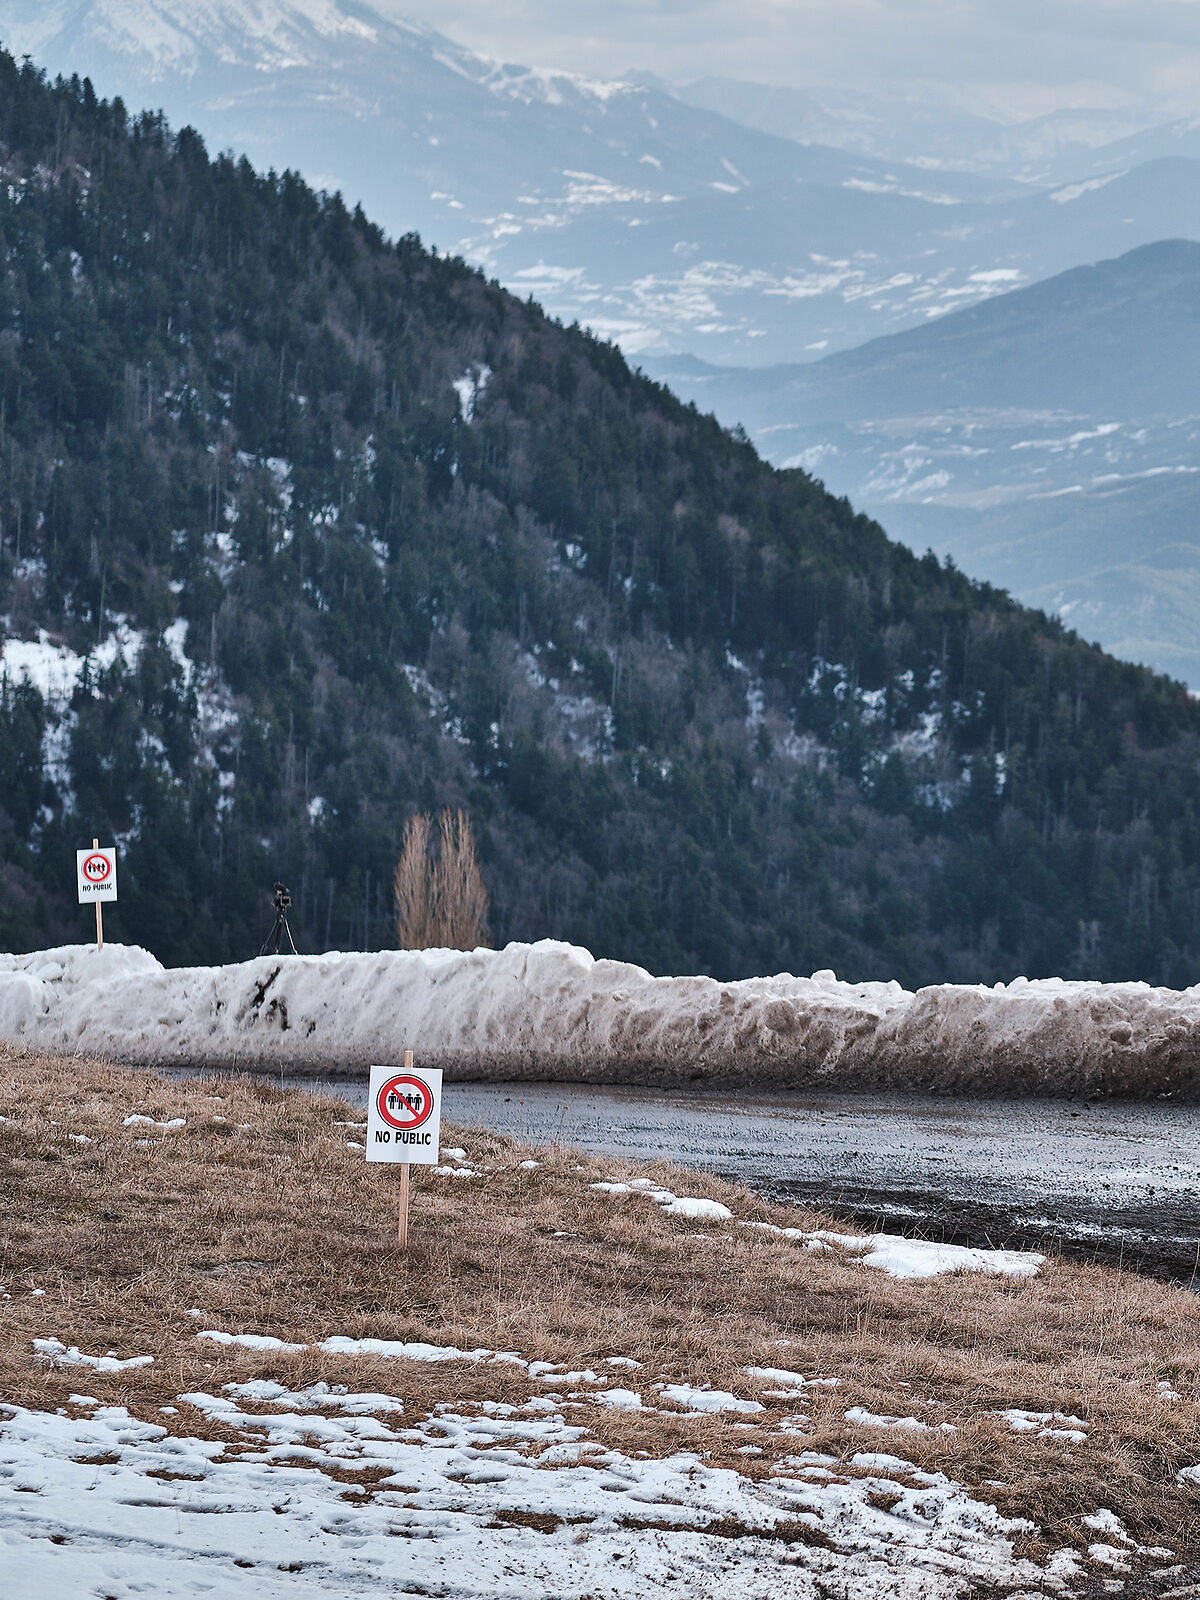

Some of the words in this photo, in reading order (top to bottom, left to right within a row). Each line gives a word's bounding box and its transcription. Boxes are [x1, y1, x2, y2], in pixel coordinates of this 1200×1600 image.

[82, 884, 91, 892] NO
[93, 883, 112, 891] PUBLIC
[375, 1131, 390, 1143] NO
[395, 1131, 431, 1145] PUBLIC
